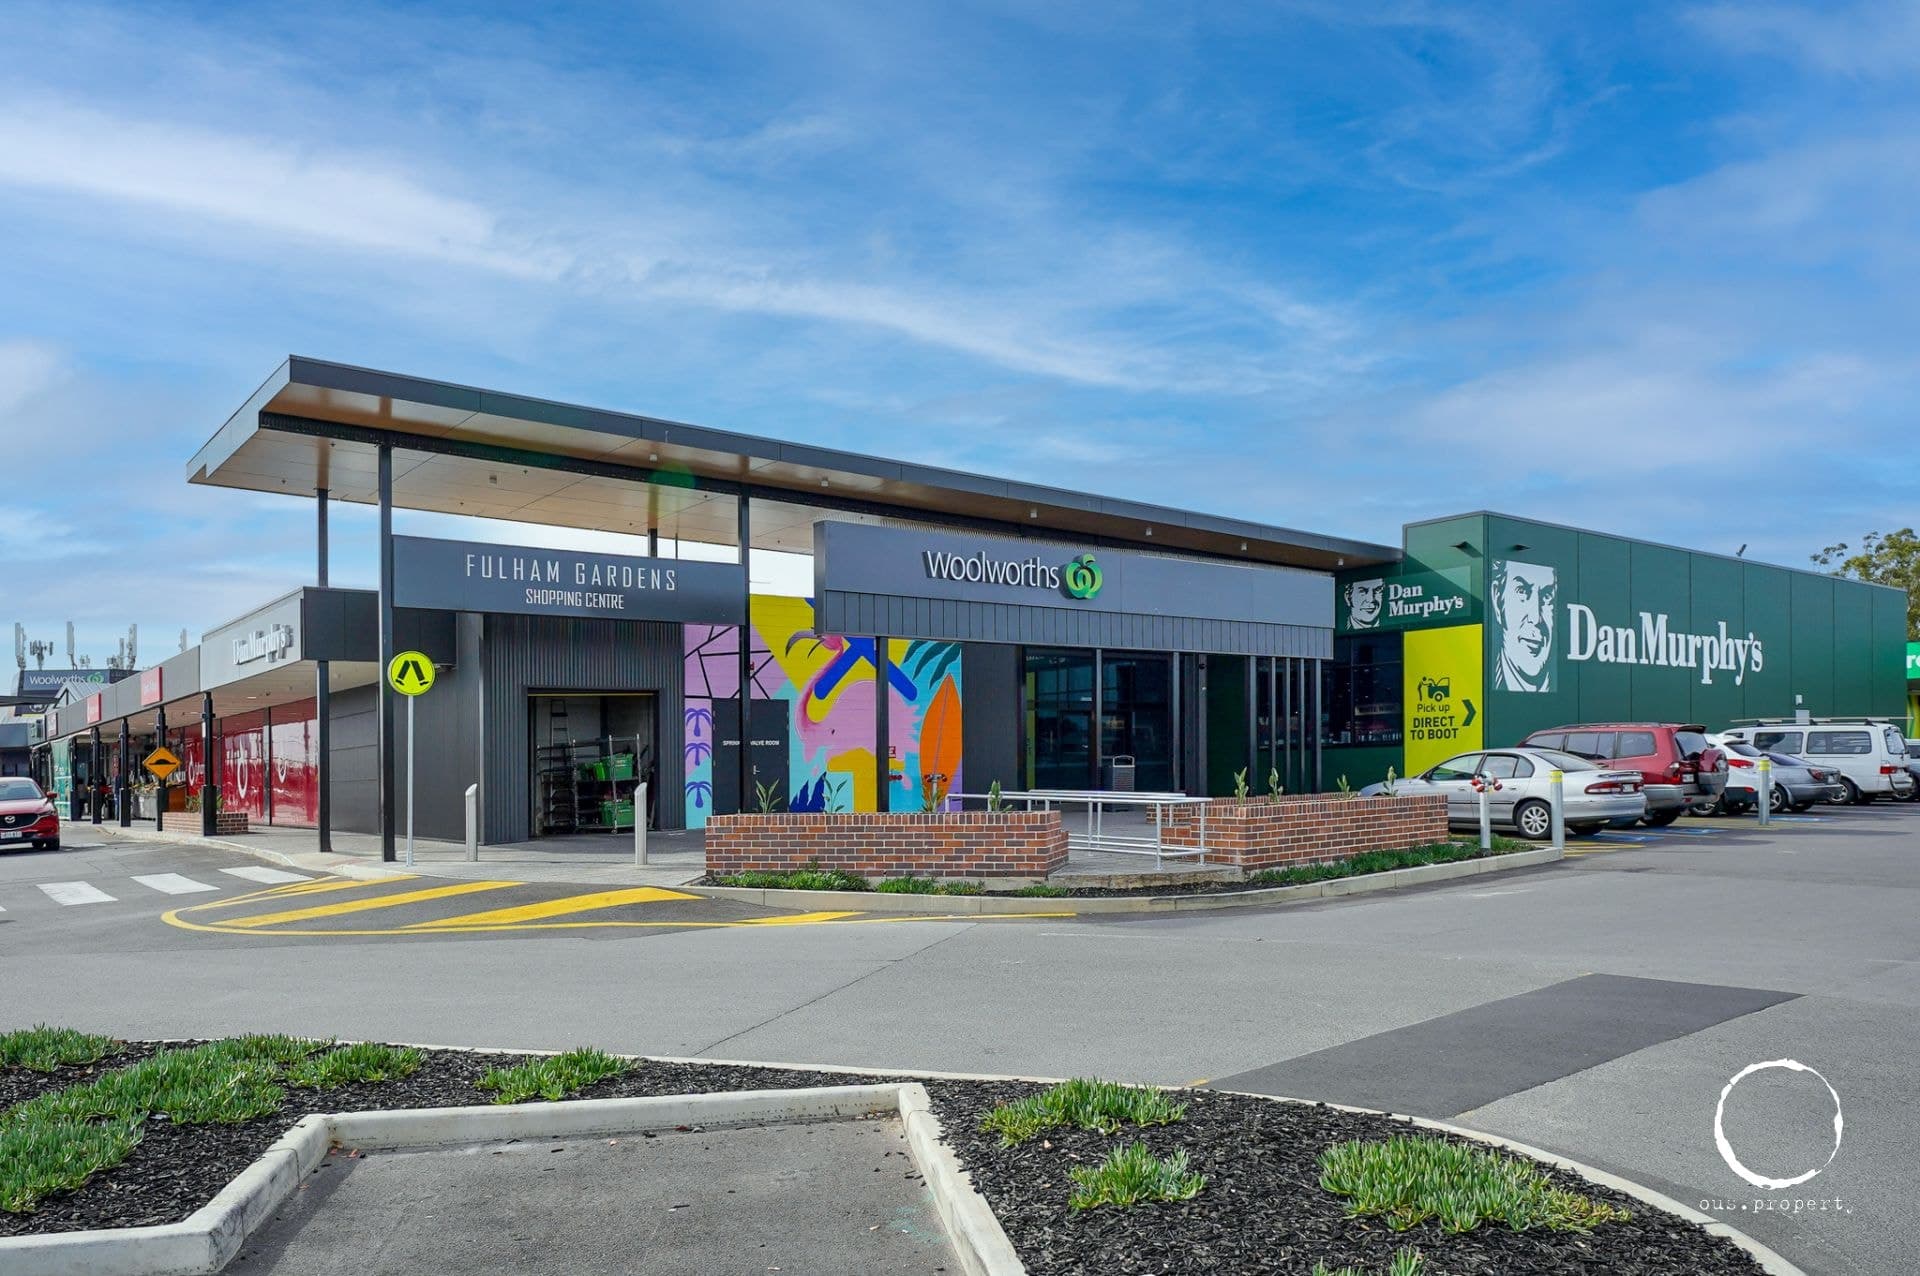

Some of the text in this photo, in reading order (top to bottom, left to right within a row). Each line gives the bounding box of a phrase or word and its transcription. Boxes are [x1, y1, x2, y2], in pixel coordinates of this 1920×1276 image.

[466, 553, 676, 591] FULHAM GARDENS
[927, 550, 1060, 589] Woolworths
[526, 588, 625, 609] SHOPPING CENTRE
[1389, 583, 1464, 617] Dan Murphy's
[1567, 603, 1764, 686] Dan Murphy's
[1413, 716, 1455, 728] DIRECT
[1417, 704, 1450, 713] Pick up
[1410, 728, 1459, 740] TO BOOT
